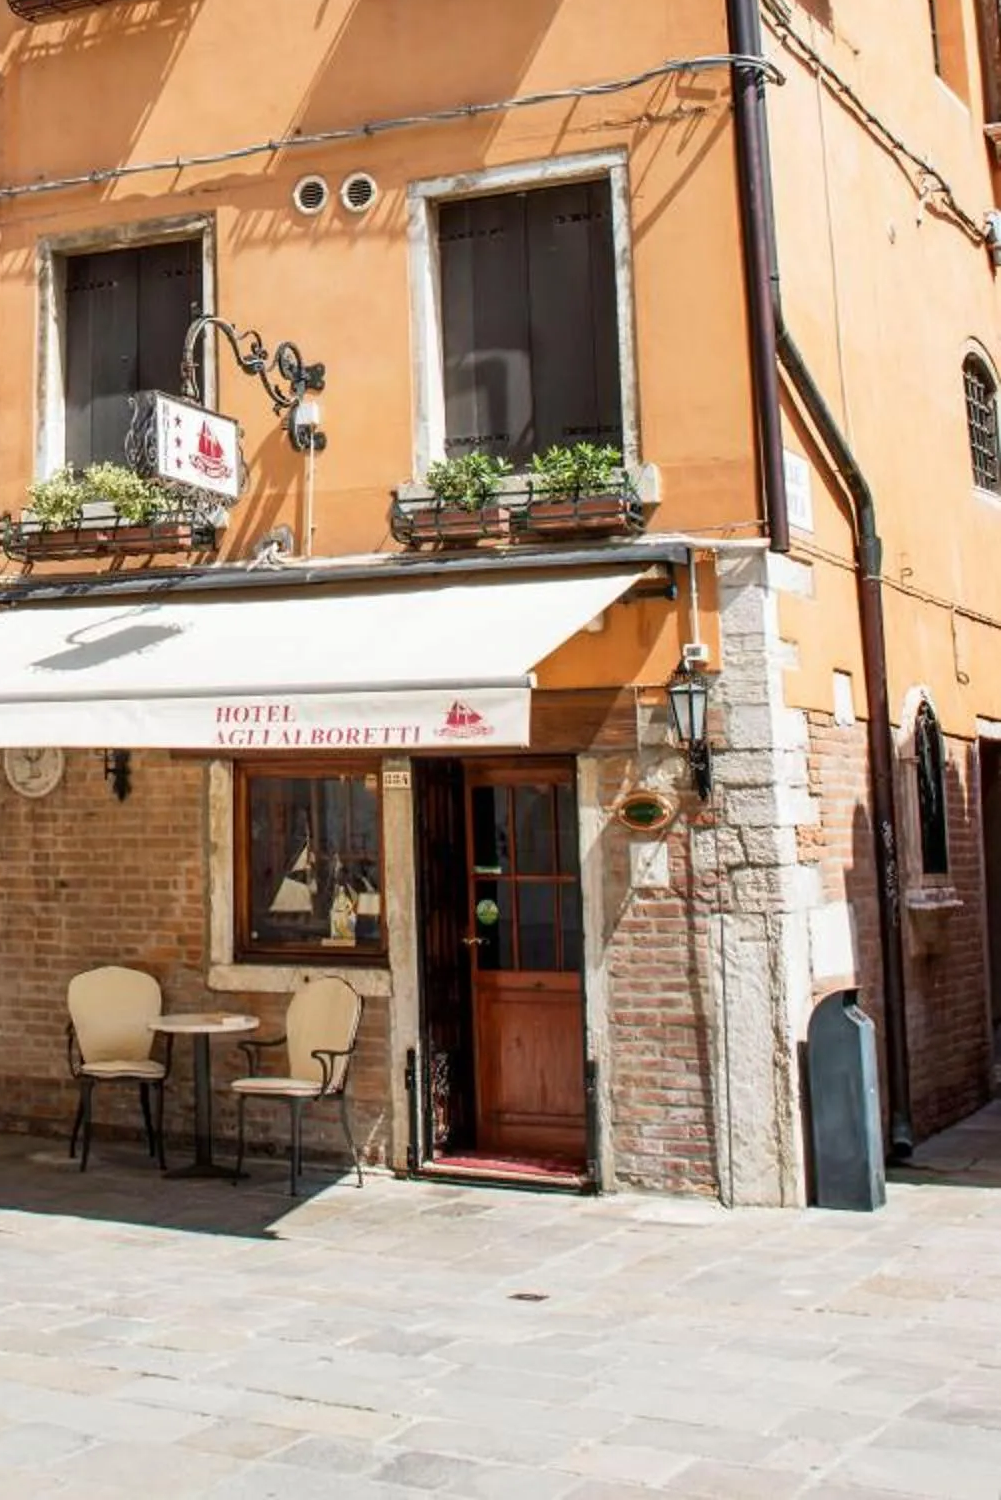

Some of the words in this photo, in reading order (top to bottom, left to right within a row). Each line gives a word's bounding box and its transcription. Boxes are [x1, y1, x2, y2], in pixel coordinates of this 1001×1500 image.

[216, 704, 295, 723] HOTEL
[216, 729, 271, 745] AGLI
[281, 726, 420, 745] ALBORETTI
